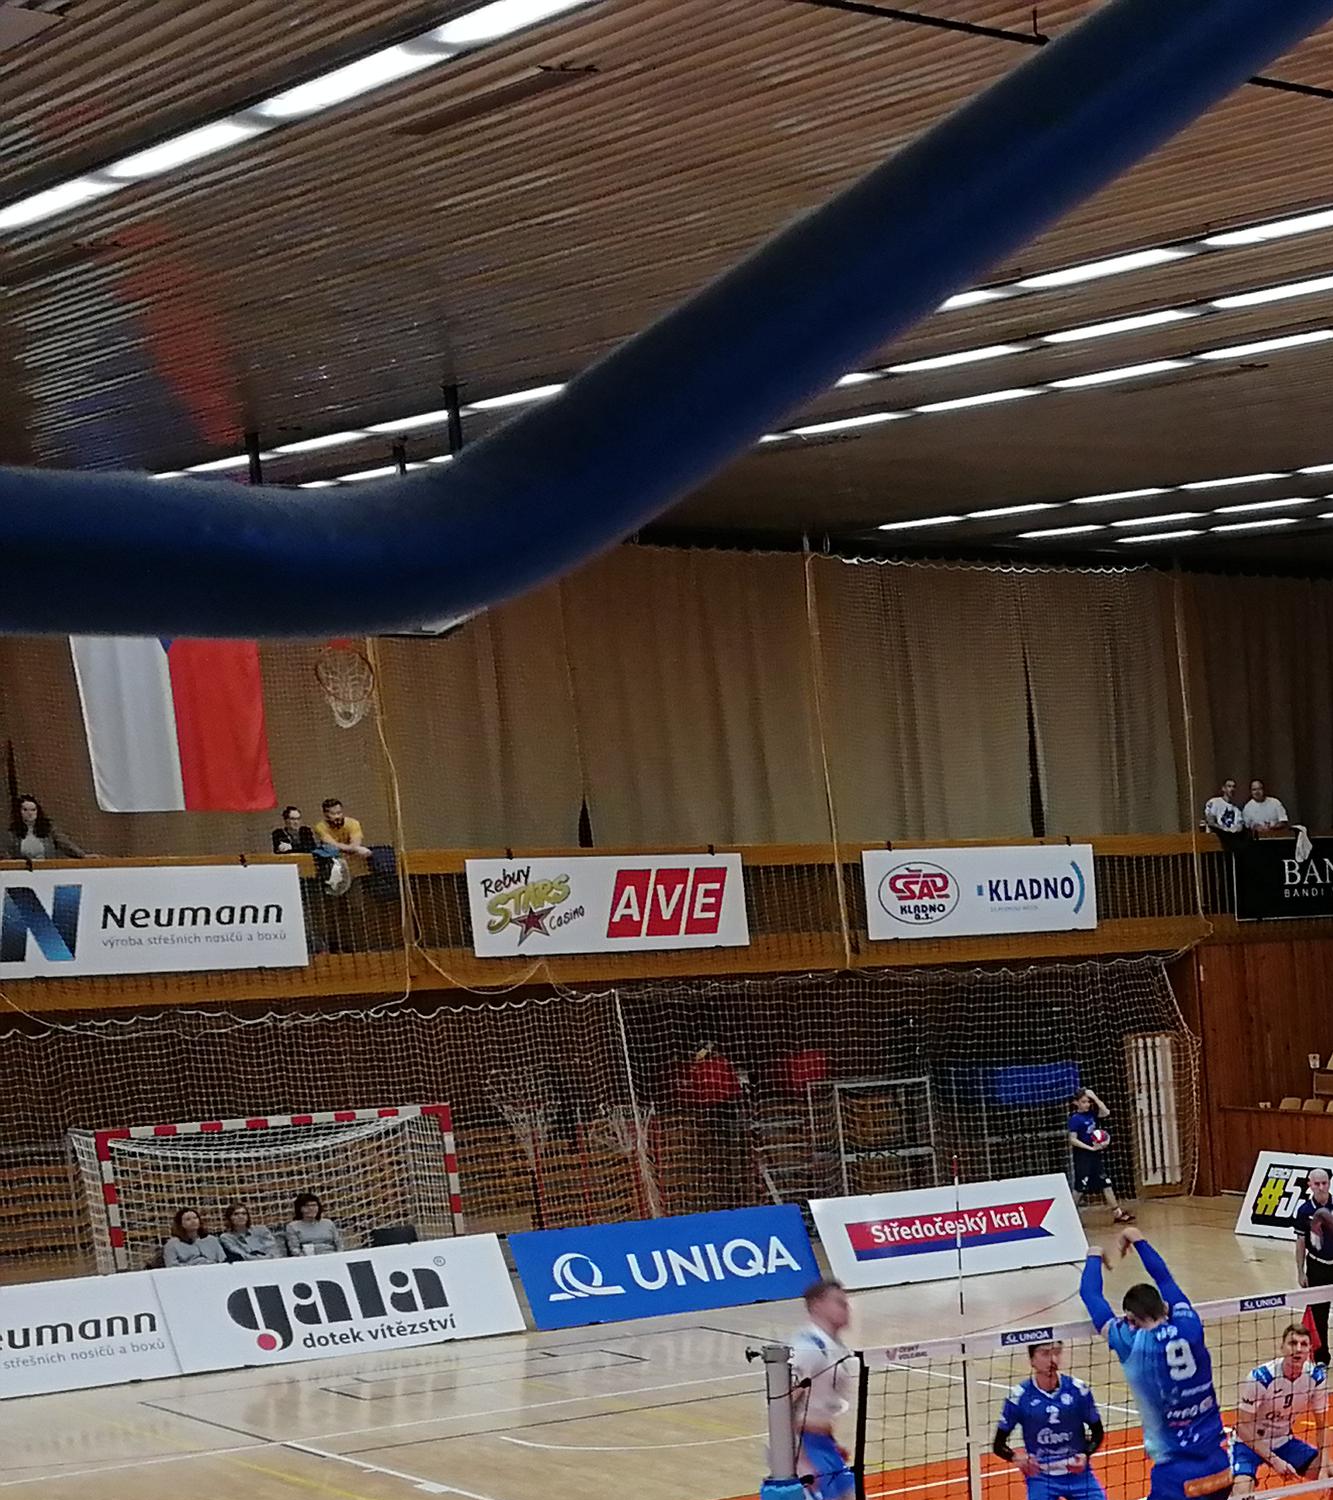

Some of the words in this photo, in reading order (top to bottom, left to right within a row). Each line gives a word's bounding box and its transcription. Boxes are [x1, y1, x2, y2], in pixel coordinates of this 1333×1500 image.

[480, 866, 531, 897] Rebuy
[988, 876, 1074, 902] KLADNO
[1283, 888, 1325, 898] BANDI
[101, 903, 283, 929] Neumann
[486, 874, 571, 934] STARS
[550, 904, 585, 931] Casino
[611, 882, 720, 922] AVE
[900, 903, 946, 915] KLADNO
[102, 936, 143, 948] výroba
[149, 931, 201, 946] střešních
[205, 931, 243, 943] nosičů
[257, 930, 286, 941] boxů
[871, 1215, 987, 1244] Středočeský
[993, 1205, 1028, 1231] kraj
[627, 1235, 801, 1291] UNIQA
[227, 1260, 449, 1352] gala
[0, 1312, 157, 1351] umann
[303, 1328, 364, 1349] dotek
[368, 1314, 456, 1341] vítězství
[3, 1353, 66, 1370] střešních
[71, 1347, 114, 1361] nosičů
[132, 1338, 165, 1353] boxů
[1165, 1338, 1197, 1382] 9
[1046, 1405, 1060, 1424] 2
